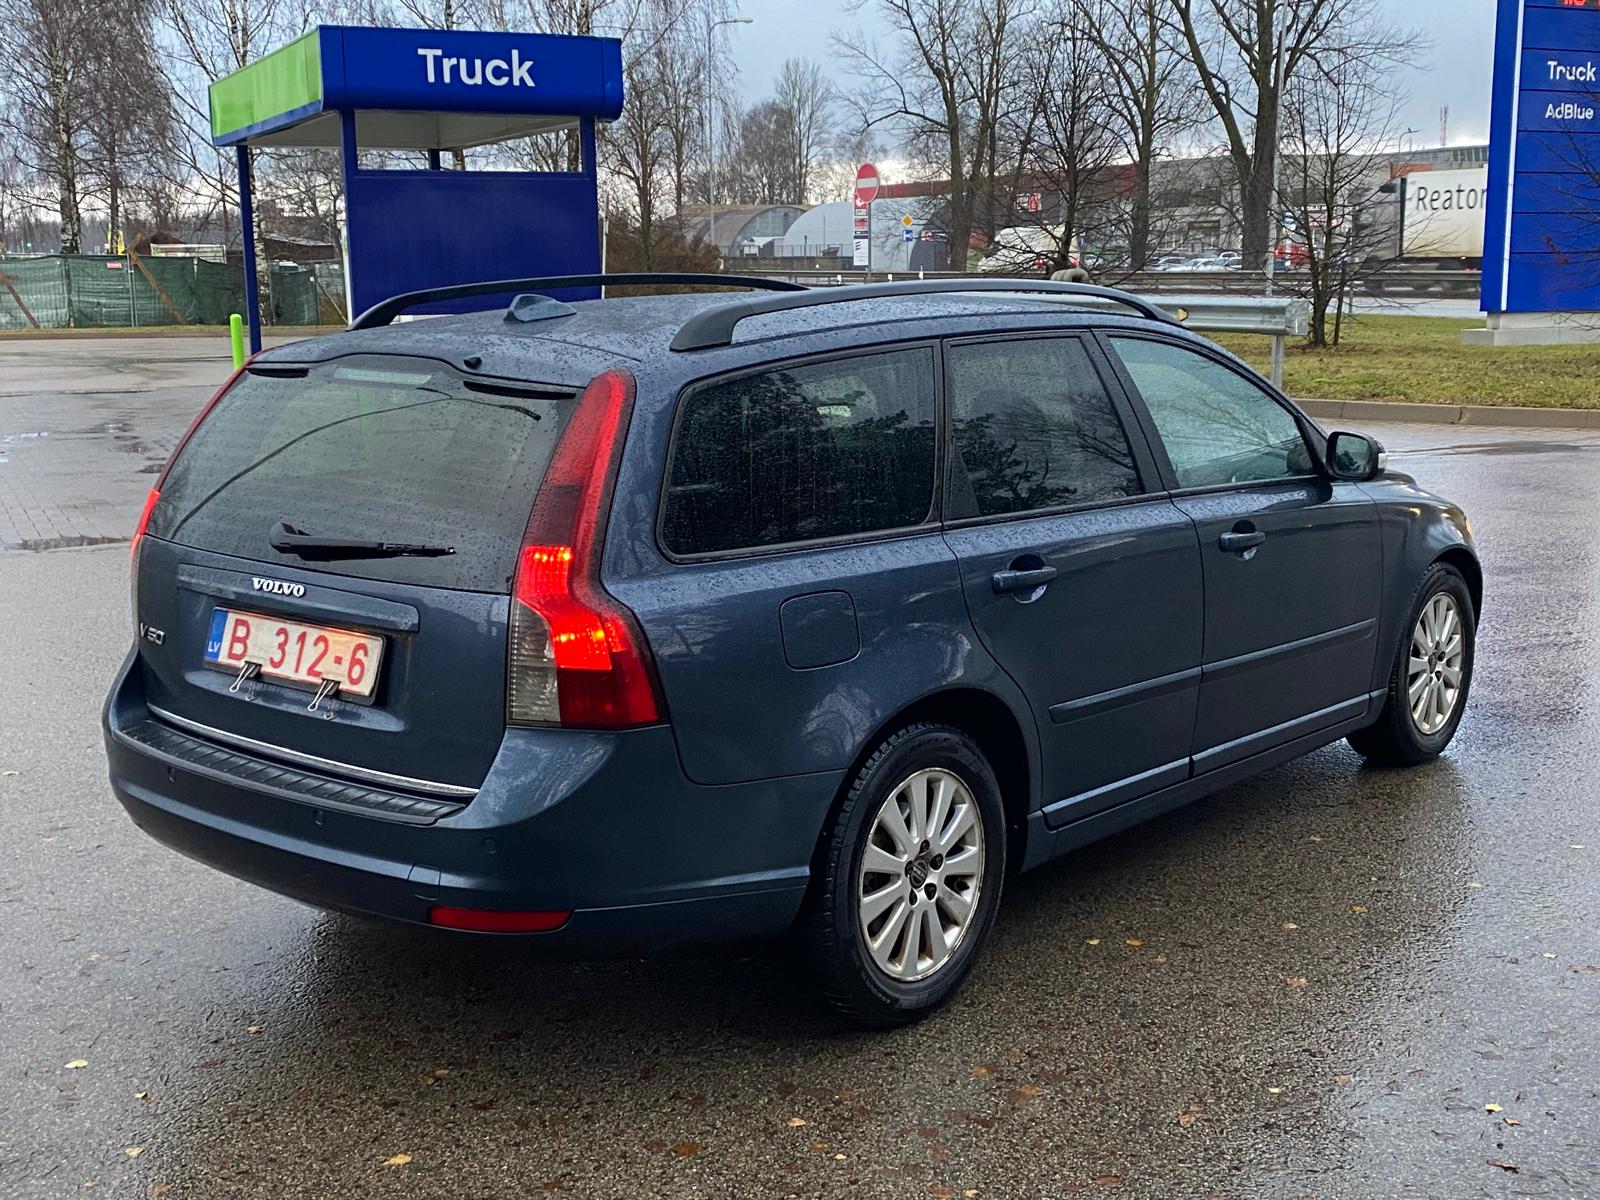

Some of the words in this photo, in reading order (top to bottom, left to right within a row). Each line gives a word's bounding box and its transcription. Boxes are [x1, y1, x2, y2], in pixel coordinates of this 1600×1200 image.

[418, 49, 535, 87] Truck
[1547, 60, 1597, 82] Truck
[1545, 102, 1594, 120] AdBlue
[252, 577, 306, 598] VOLVO
[138, 622, 165, 645] V50
[207, 639, 221, 653] LV
